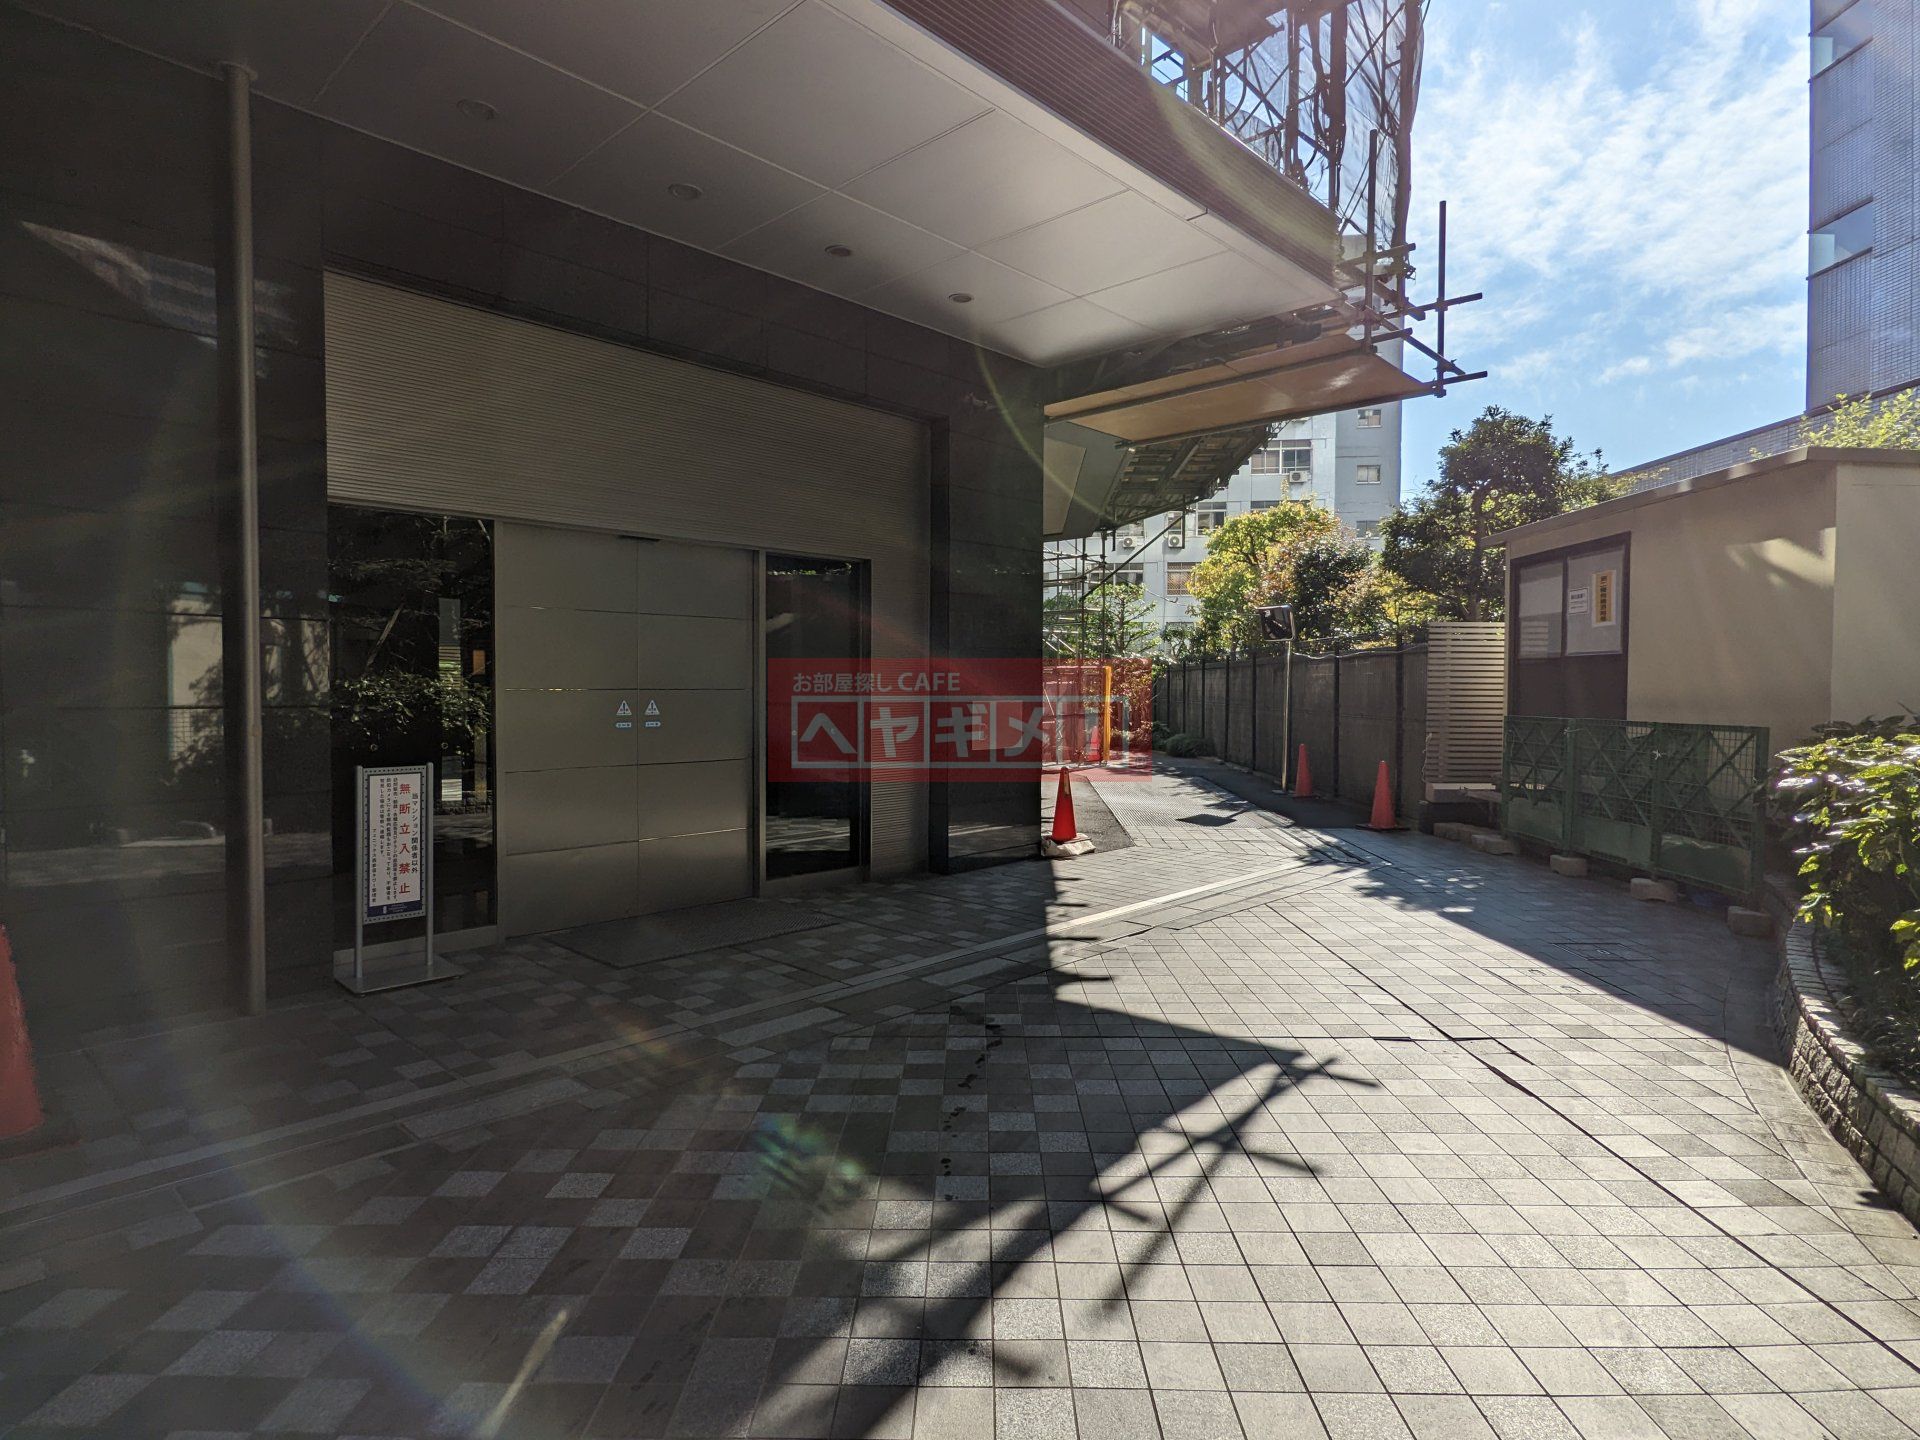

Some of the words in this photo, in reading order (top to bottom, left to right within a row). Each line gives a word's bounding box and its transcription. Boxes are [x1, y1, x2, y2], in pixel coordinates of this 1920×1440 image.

[399, 783, 411, 895] 無断立入禁止
[411, 793, 419, 873] 当マンション関係者以外
